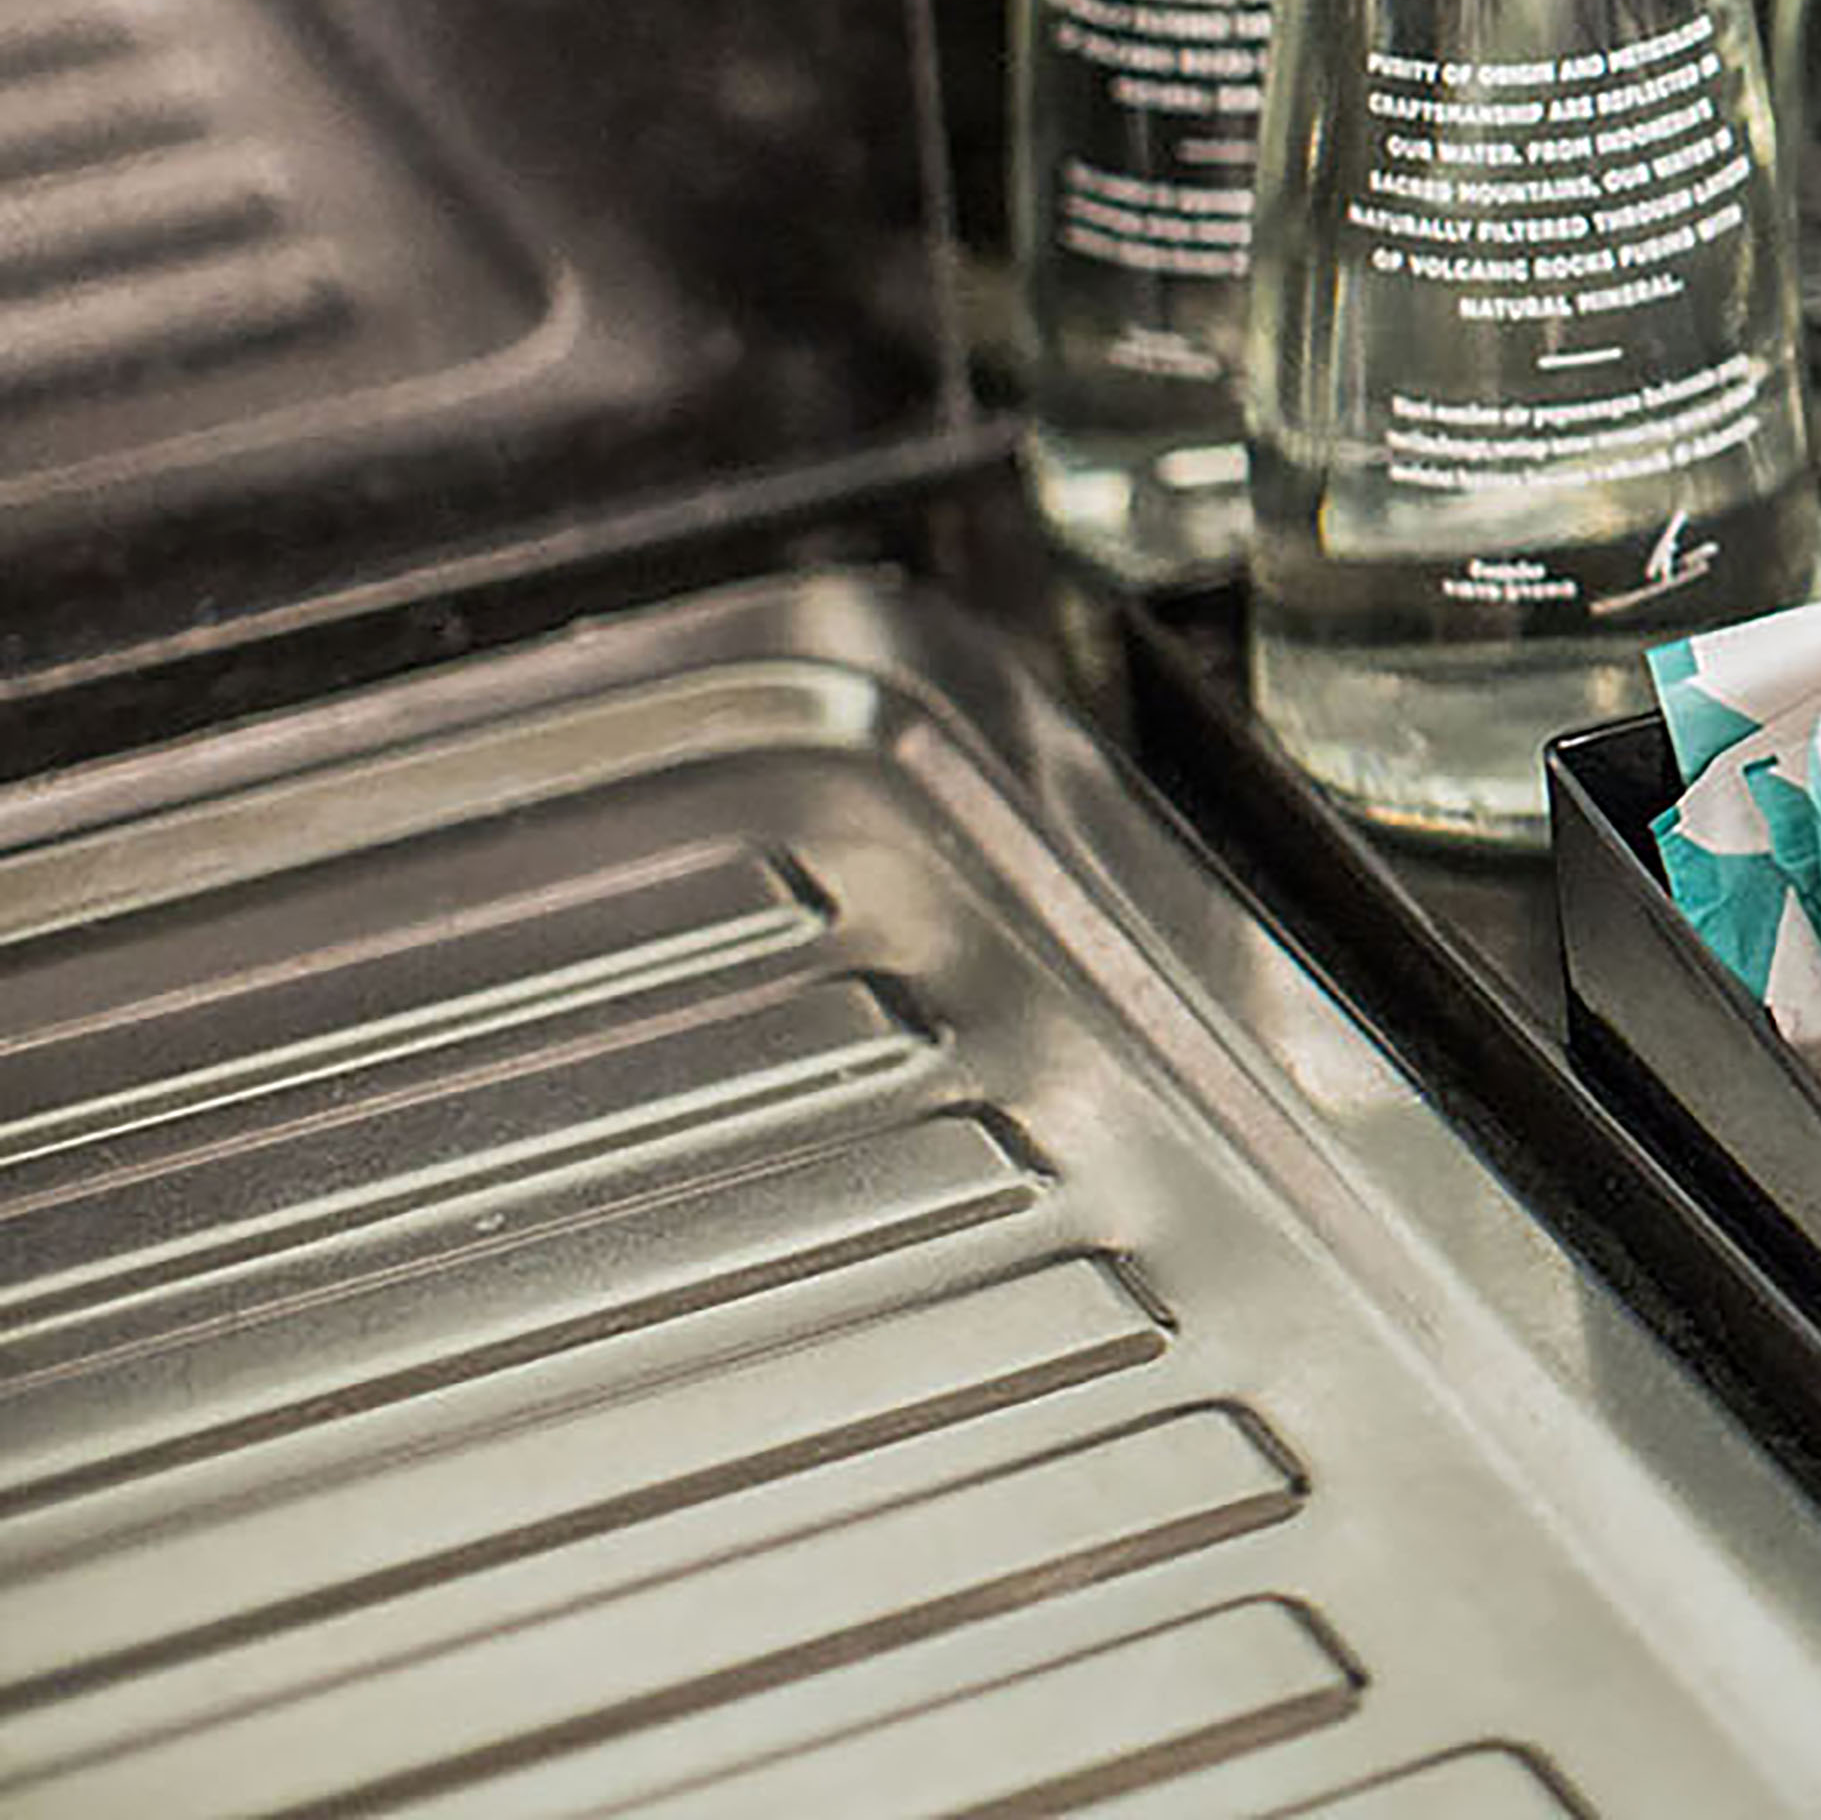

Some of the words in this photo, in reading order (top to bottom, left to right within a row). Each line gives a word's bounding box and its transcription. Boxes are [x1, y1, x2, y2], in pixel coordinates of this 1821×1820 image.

[1367, 52, 1438, 84] PURITY
[1441, 62, 1472, 85] OF
[1386, 134, 1433, 161] OUR
[1527, 136, 1593, 165] FROM
[1602, 162, 1650, 192] OUR
[1348, 202, 1473, 242] NATURALLY
[1477, 215, 1589, 243] FILTERED
[1372, 247, 1404, 272] OF
[1409, 254, 1528, 282] VOLCANIC
[1533, 250, 1616, 280] ROCKS
[1459, 295, 1574, 321] NATURAL
